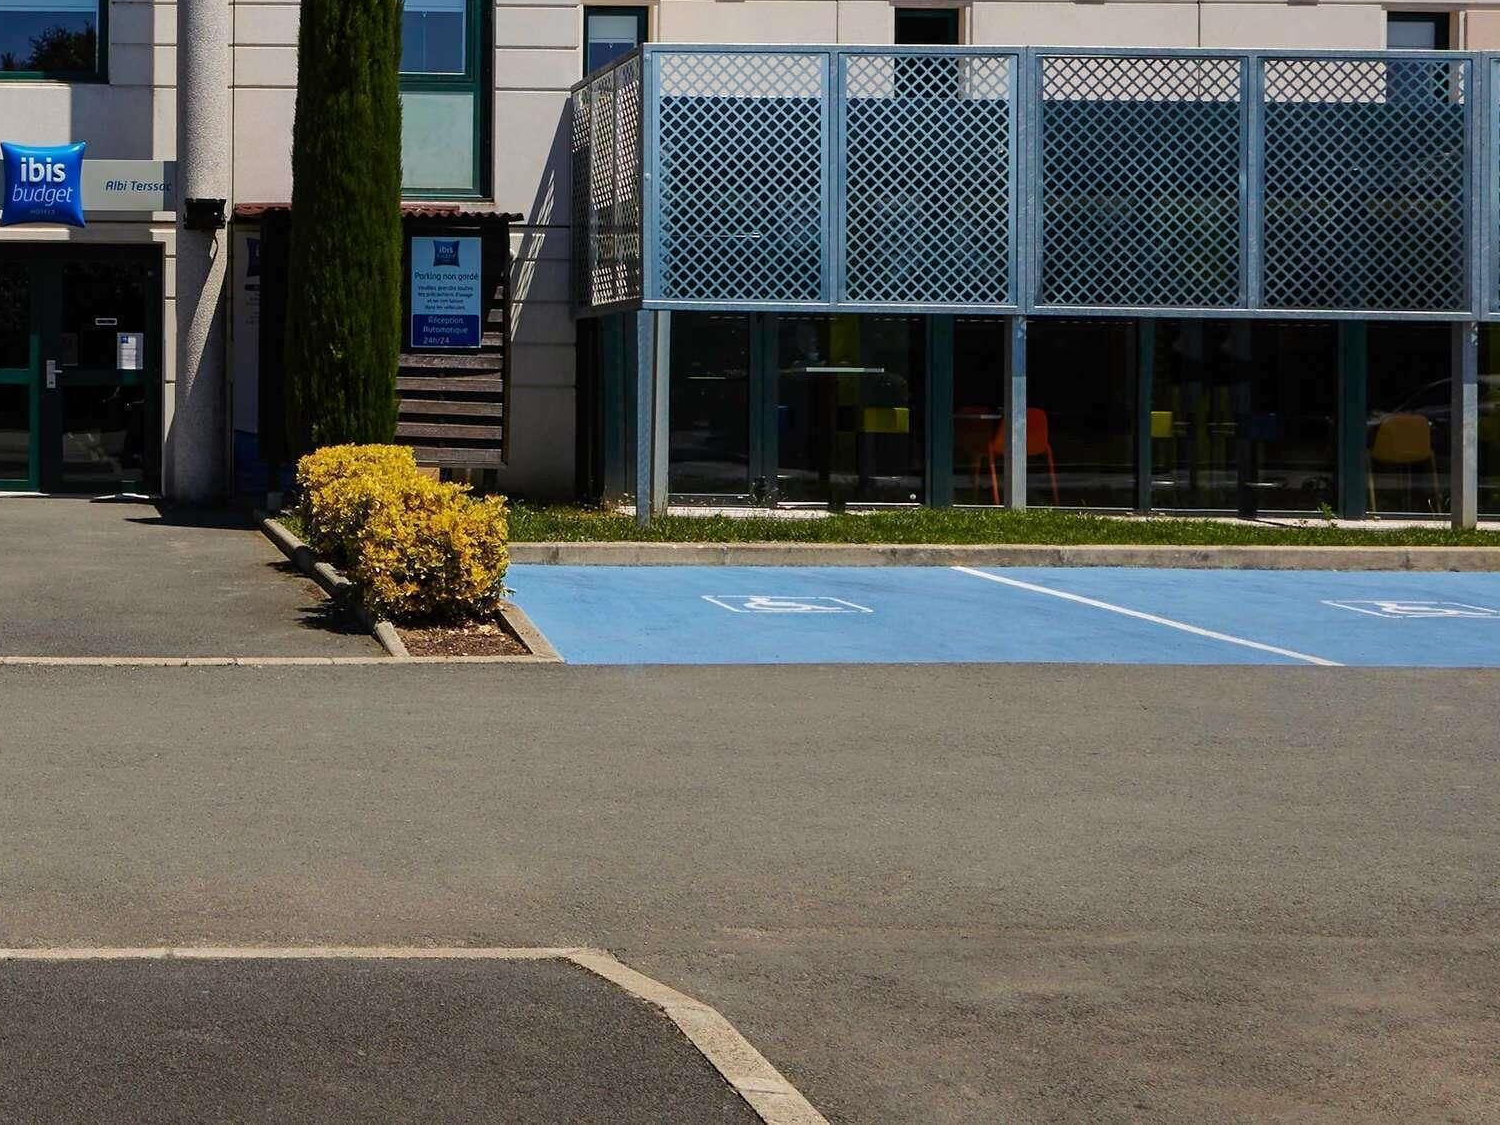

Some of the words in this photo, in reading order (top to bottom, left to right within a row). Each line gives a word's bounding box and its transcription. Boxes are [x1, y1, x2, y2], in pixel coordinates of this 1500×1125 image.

[21, 157, 66, 182] ibis
[106, 181, 127, 192] Albi
[12, 184, 73, 207] budget
[414, 271, 442, 281] Parking
